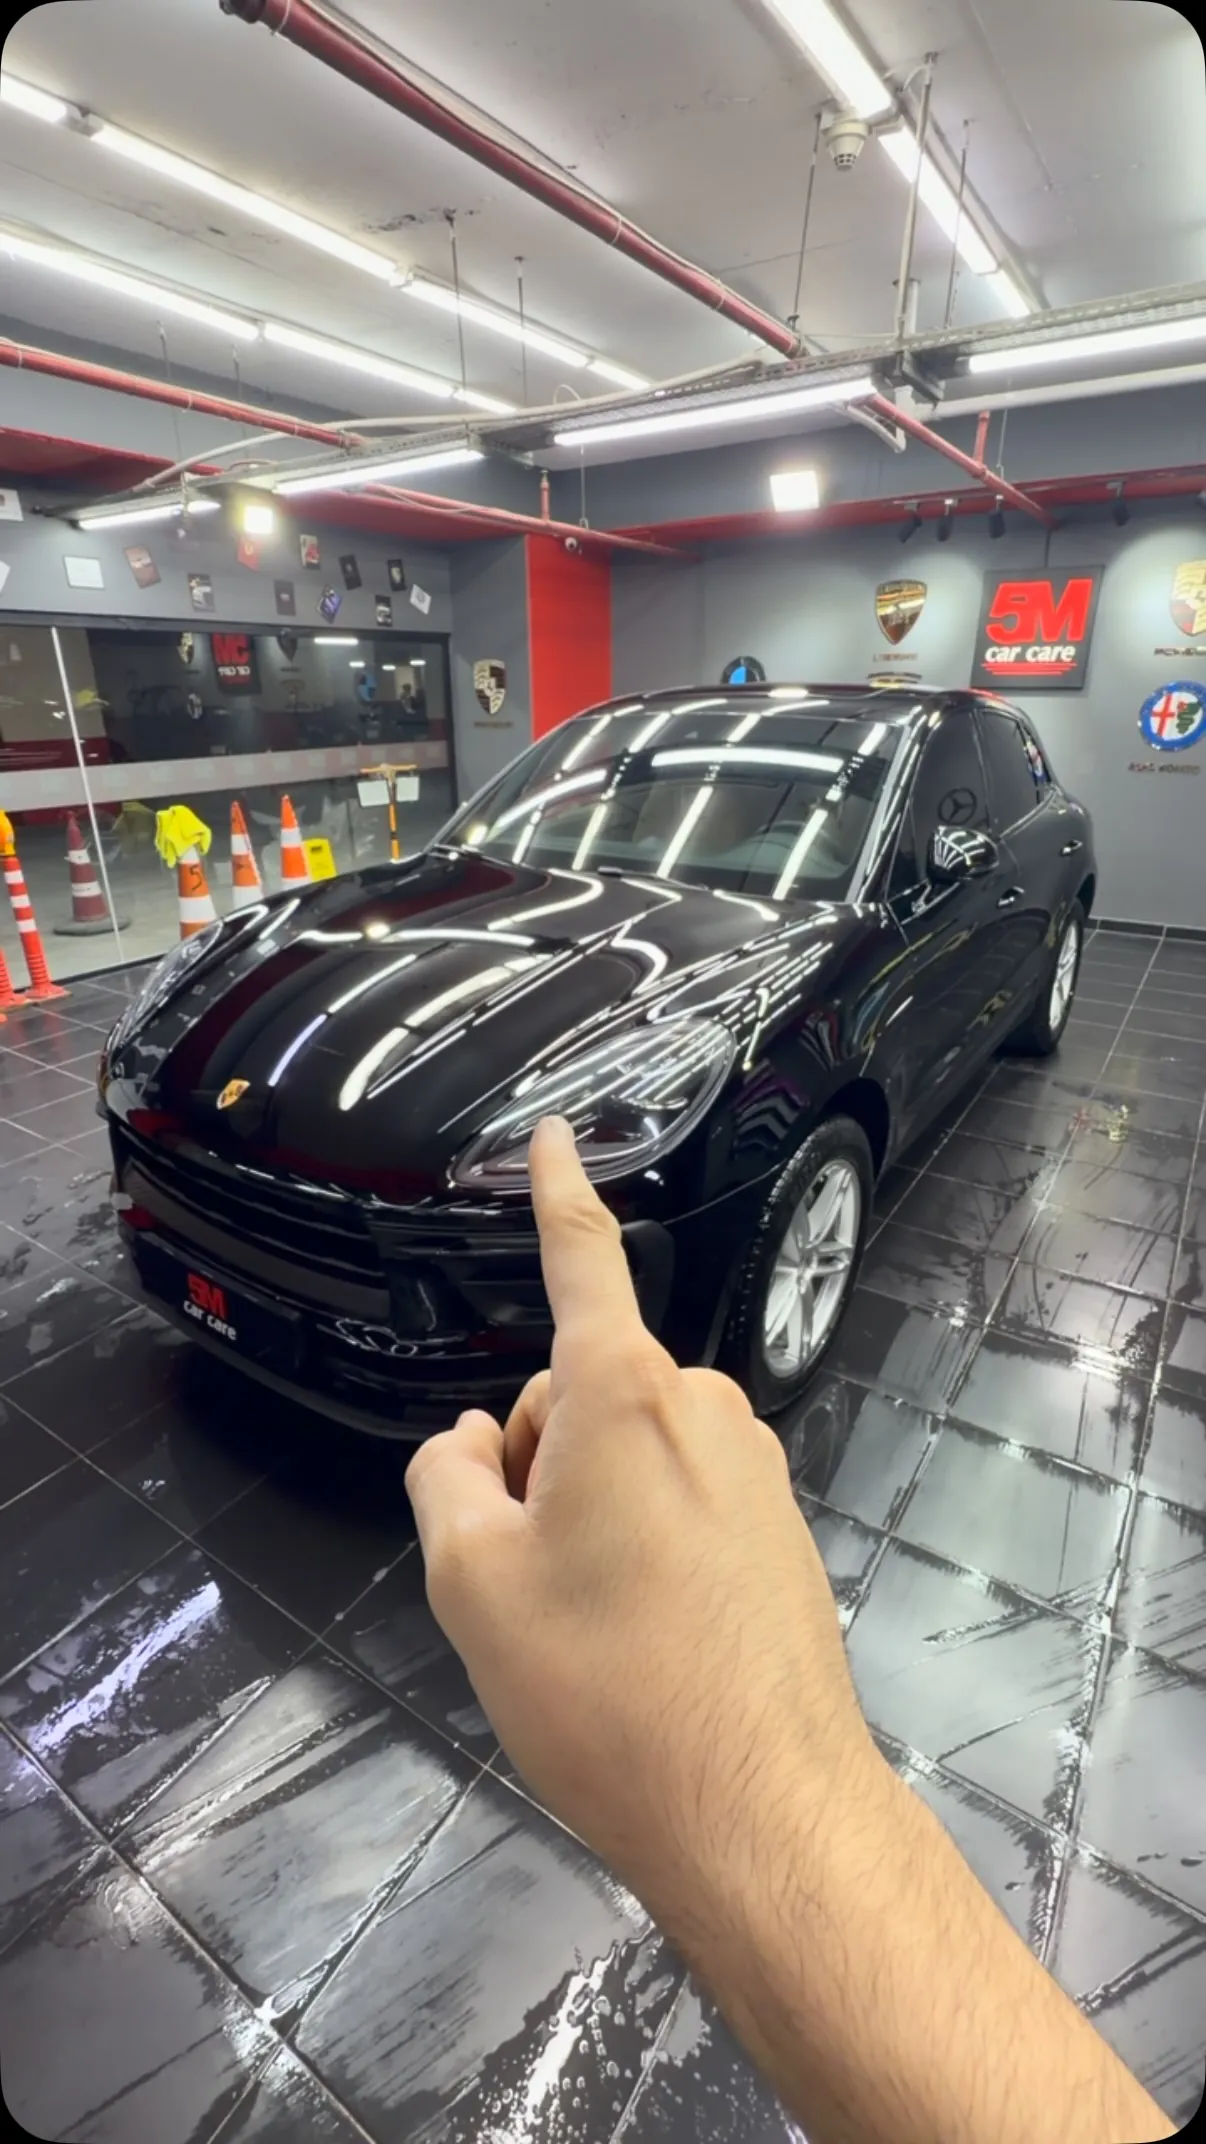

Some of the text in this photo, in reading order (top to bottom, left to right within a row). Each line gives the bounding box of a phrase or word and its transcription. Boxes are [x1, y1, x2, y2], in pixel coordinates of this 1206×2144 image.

[986, 579, 1093, 645] 5M
[984, 645, 1076, 663] car care
[187, 1272, 226, 1320] 5M
[183, 1299, 237, 1341] car care
